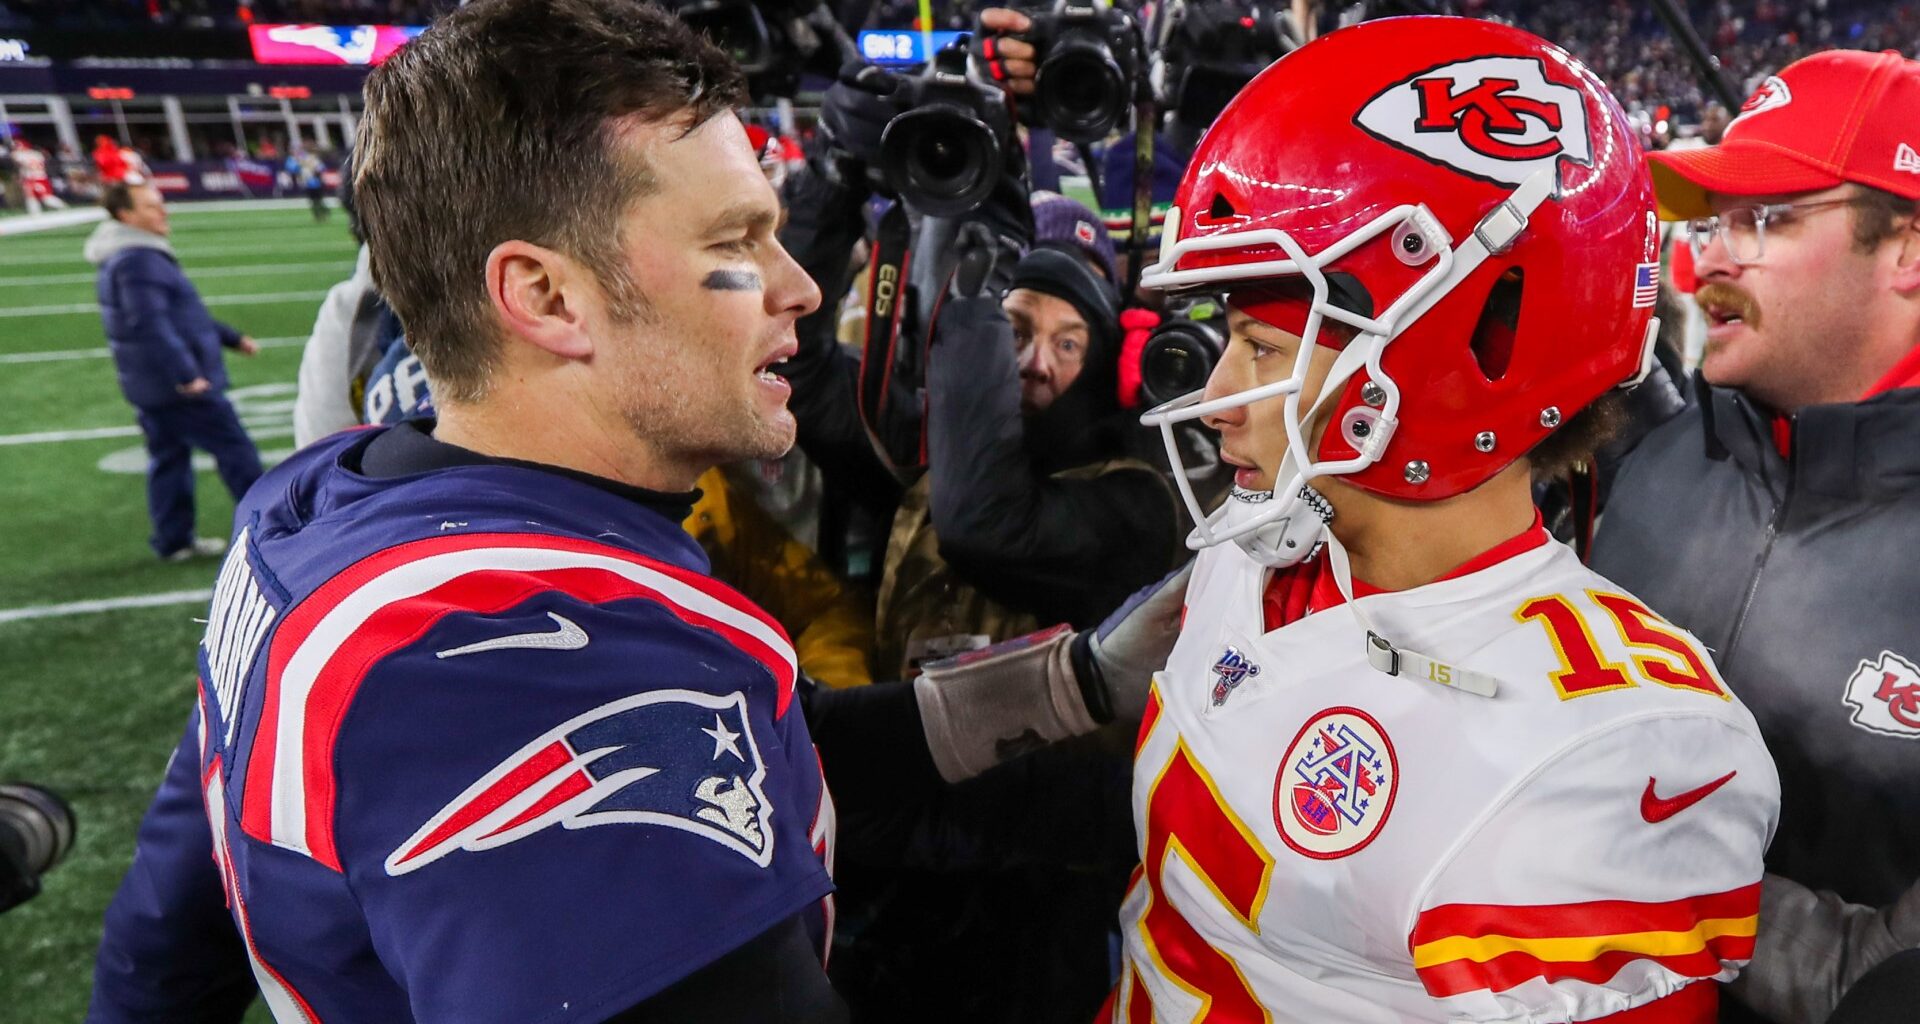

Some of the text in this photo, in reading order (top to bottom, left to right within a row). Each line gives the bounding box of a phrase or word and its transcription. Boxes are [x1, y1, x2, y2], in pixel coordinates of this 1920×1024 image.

[1411, 77, 1564, 161] KC
[876, 264, 898, 316] EOS
[1428, 661, 1452, 685] 15
[1511, 587, 1733, 701] 15
